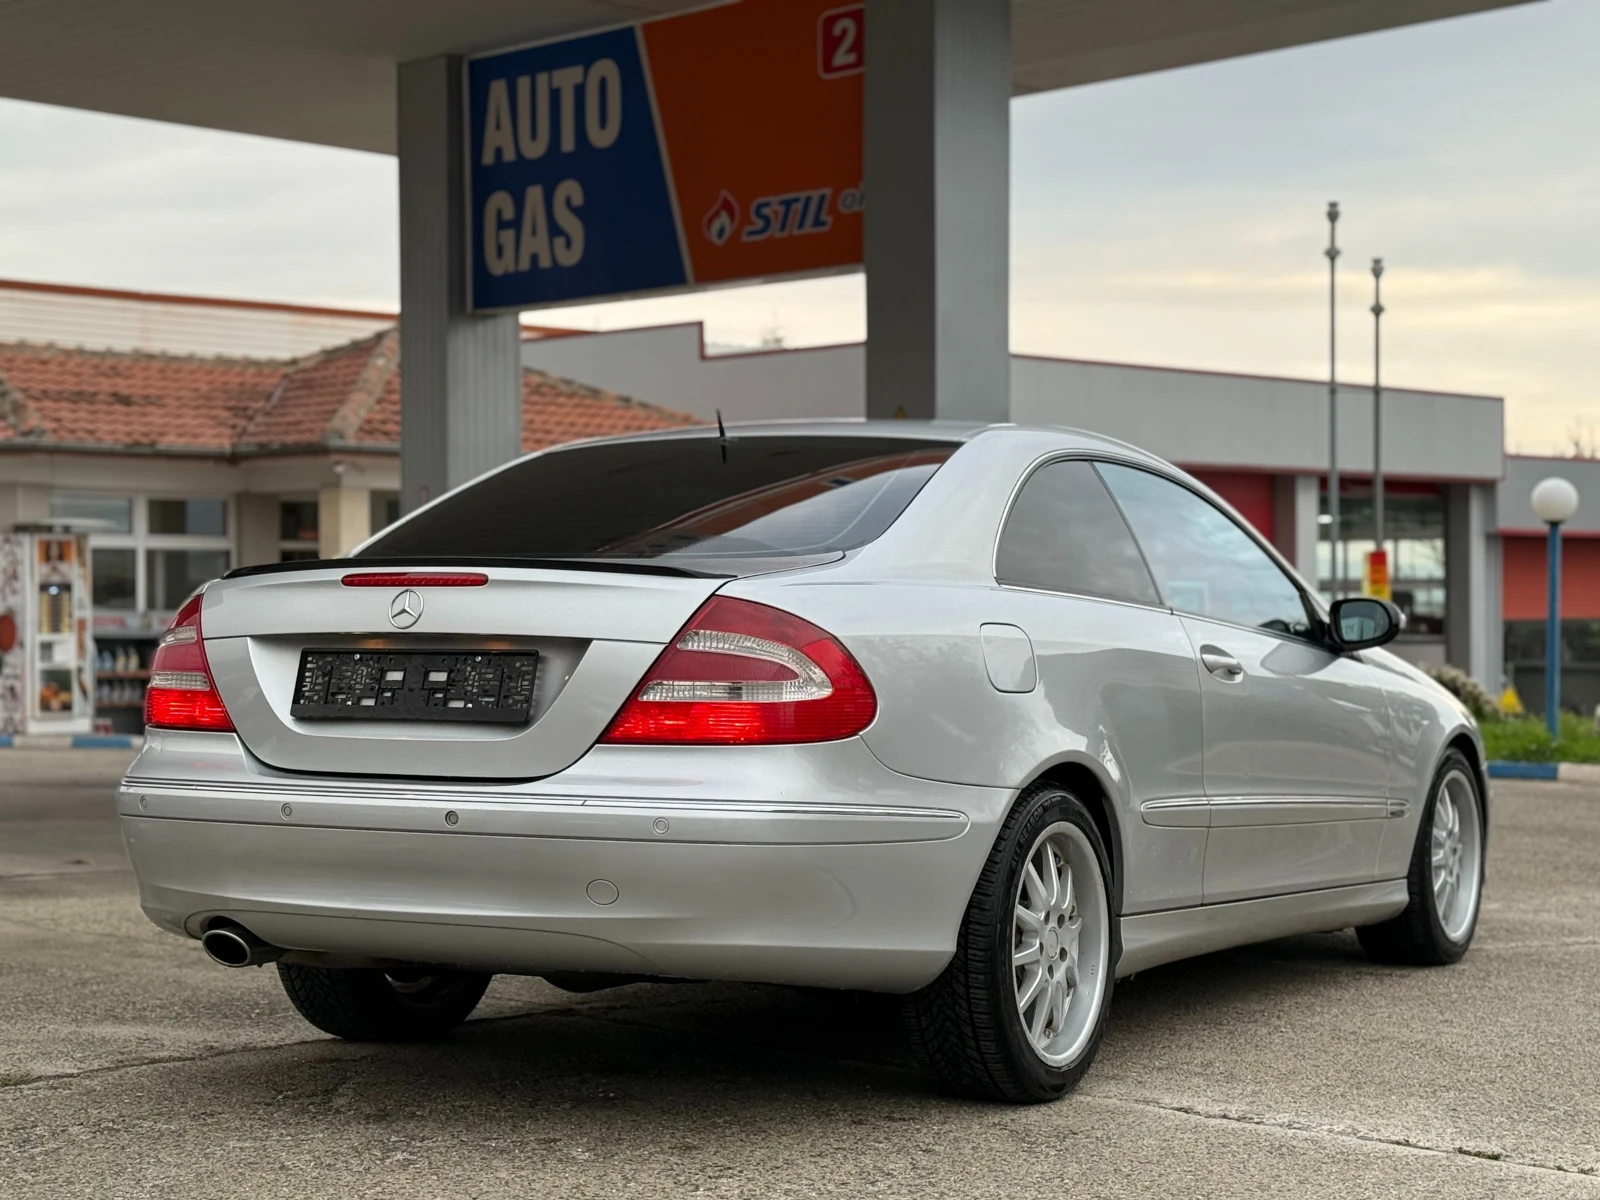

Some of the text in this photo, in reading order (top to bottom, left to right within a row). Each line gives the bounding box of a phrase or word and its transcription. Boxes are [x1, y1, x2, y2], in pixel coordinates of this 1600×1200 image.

[831, 17, 858, 68] 2
[481, 58, 622, 166] AUTO
[483, 178, 586, 278] GAS
[743, 189, 832, 240] STIL
